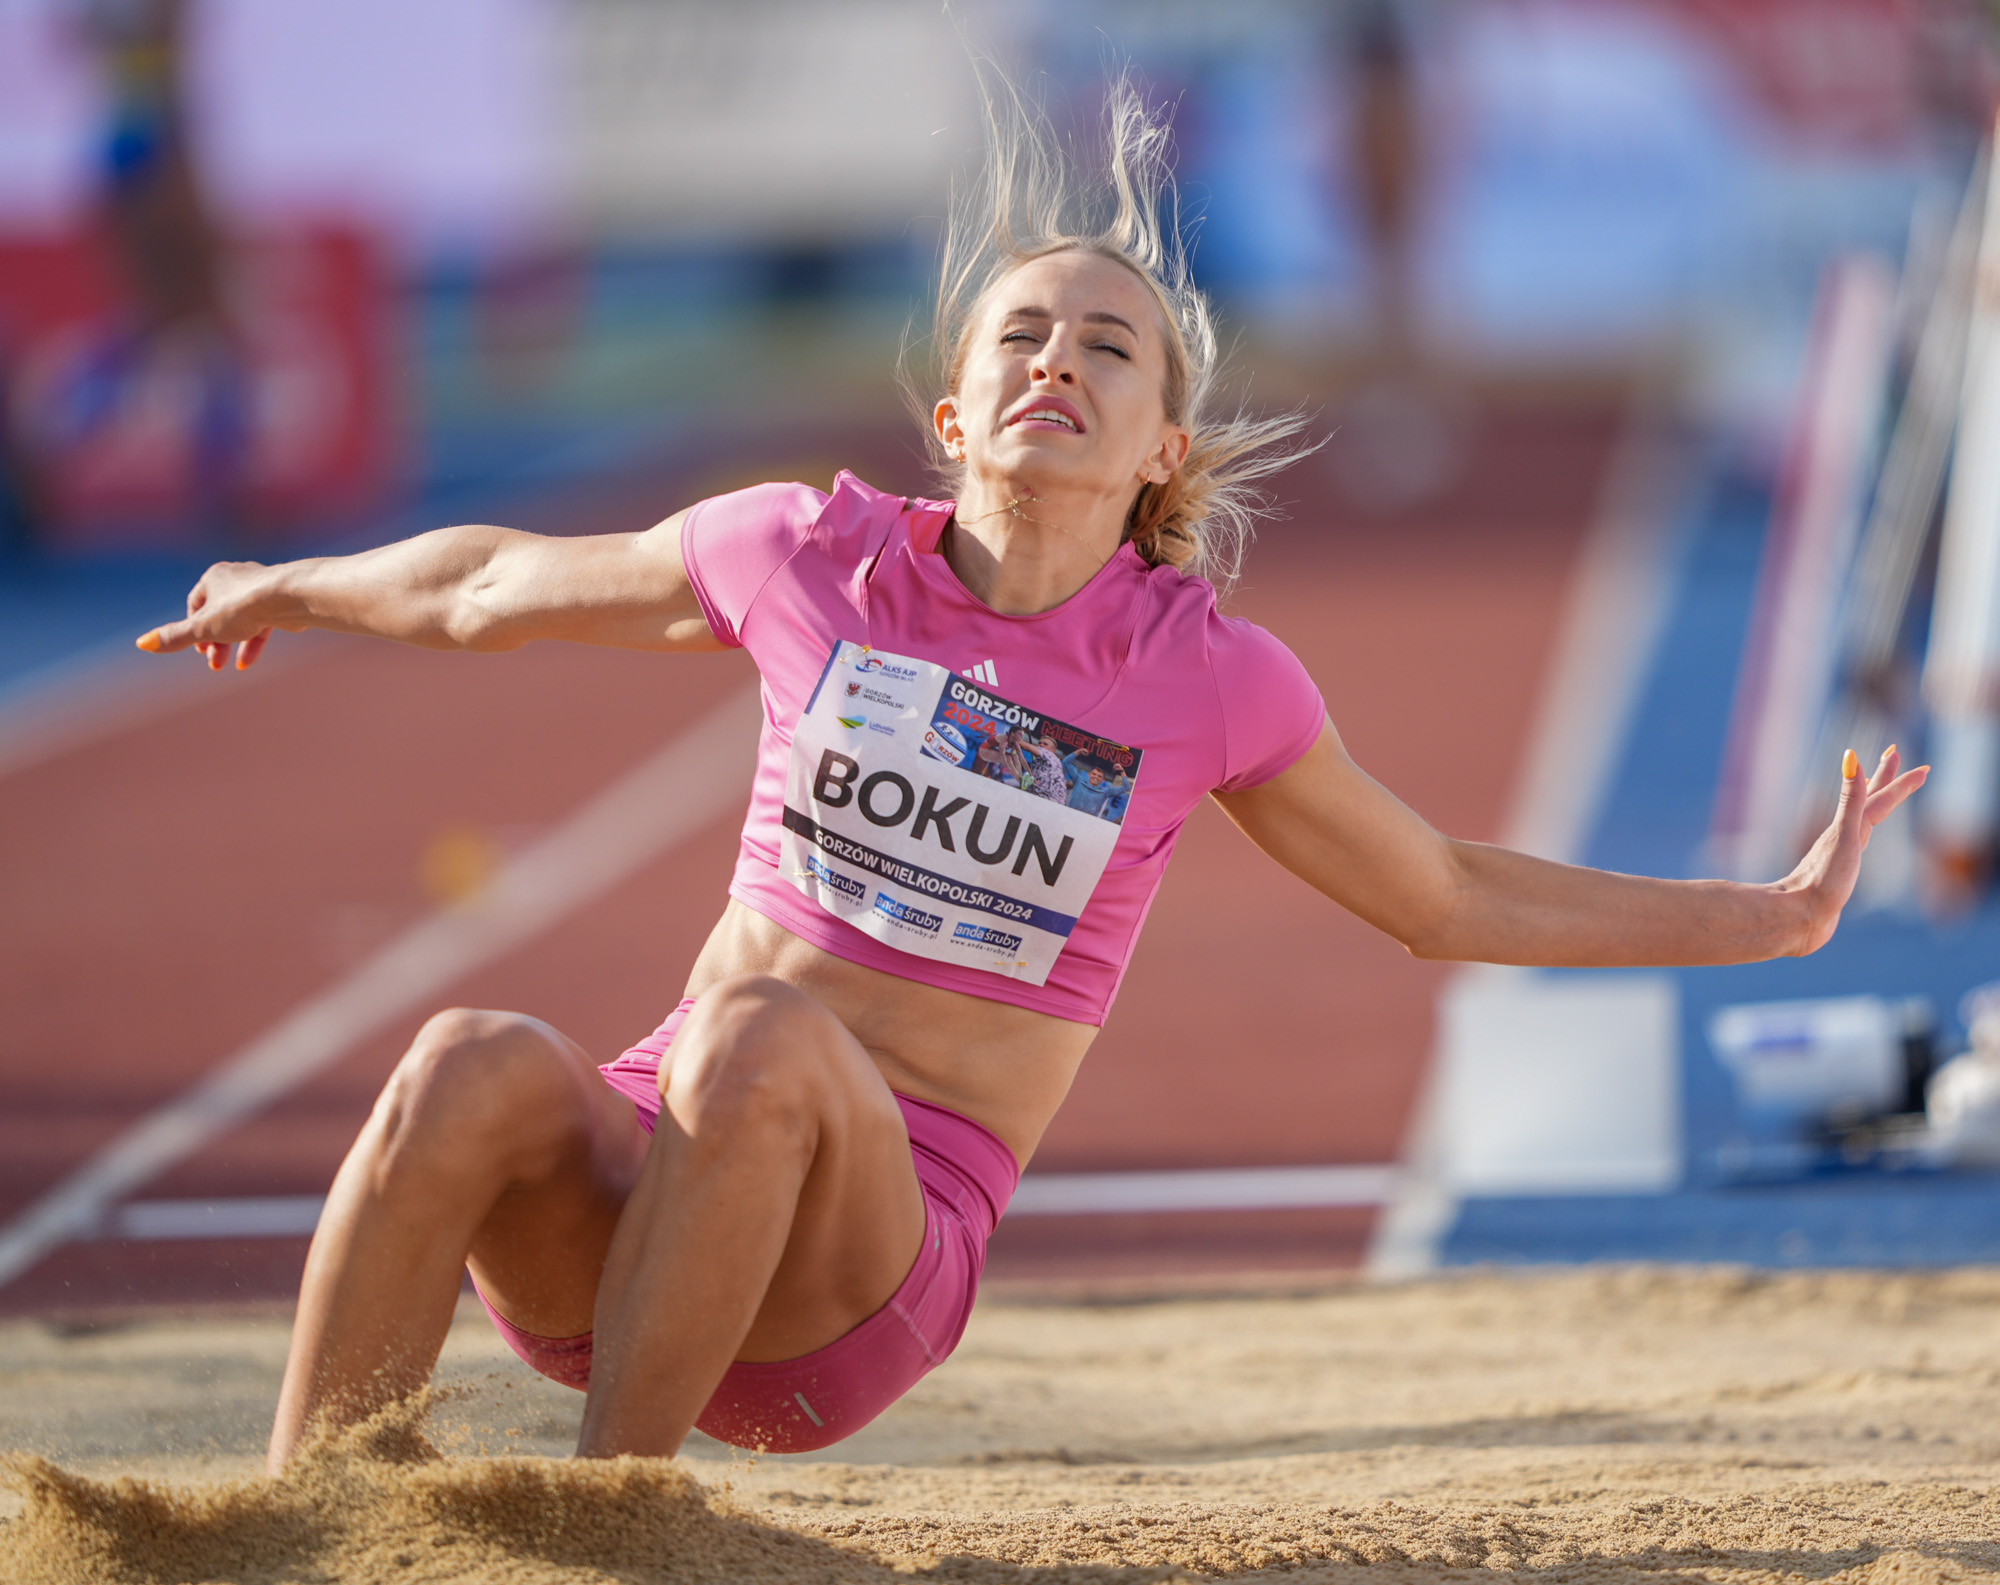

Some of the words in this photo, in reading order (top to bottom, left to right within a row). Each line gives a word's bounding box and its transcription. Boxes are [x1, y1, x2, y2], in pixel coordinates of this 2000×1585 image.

[881, 664, 901, 673] ALKS
[863, 694, 905, 709] WIELKOPOLSKI
[865, 688, 893, 700] GORZÓW
[943, 702, 997, 735] 2024
[950, 681, 1040, 731] GORZÓW
[1041, 720, 1134, 767] MEETING
[812, 748, 1074, 887] BOKUN
[815, 829, 879, 868] GORZÓW
[880, 858, 995, 908] WIELKOPOLSKI
[993, 899, 1033, 920] 2024
[872, 910, 938, 940] www.anda-sruby.pl
[950, 939, 1016, 958] www.anda-sruby.pl
